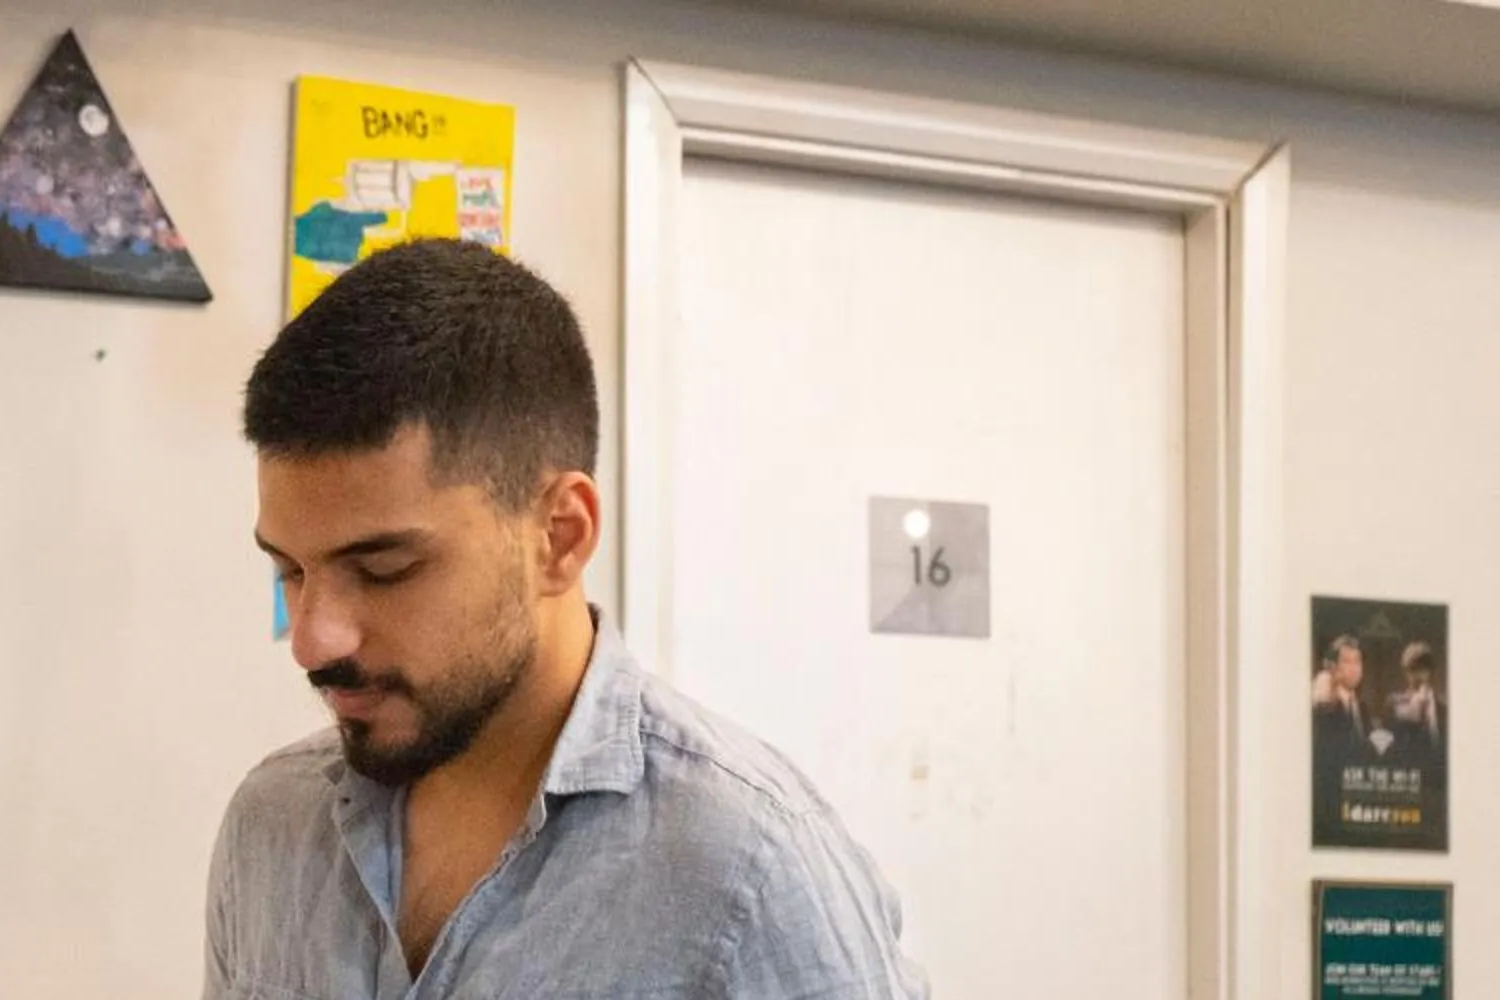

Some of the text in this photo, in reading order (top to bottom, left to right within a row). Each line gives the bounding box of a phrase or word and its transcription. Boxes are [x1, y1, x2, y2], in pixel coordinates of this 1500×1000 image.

[911, 545, 952, 588] 16
[1325, 918, 1391, 936] VOLUNTEER
[1395, 920, 1424, 937] WITH
